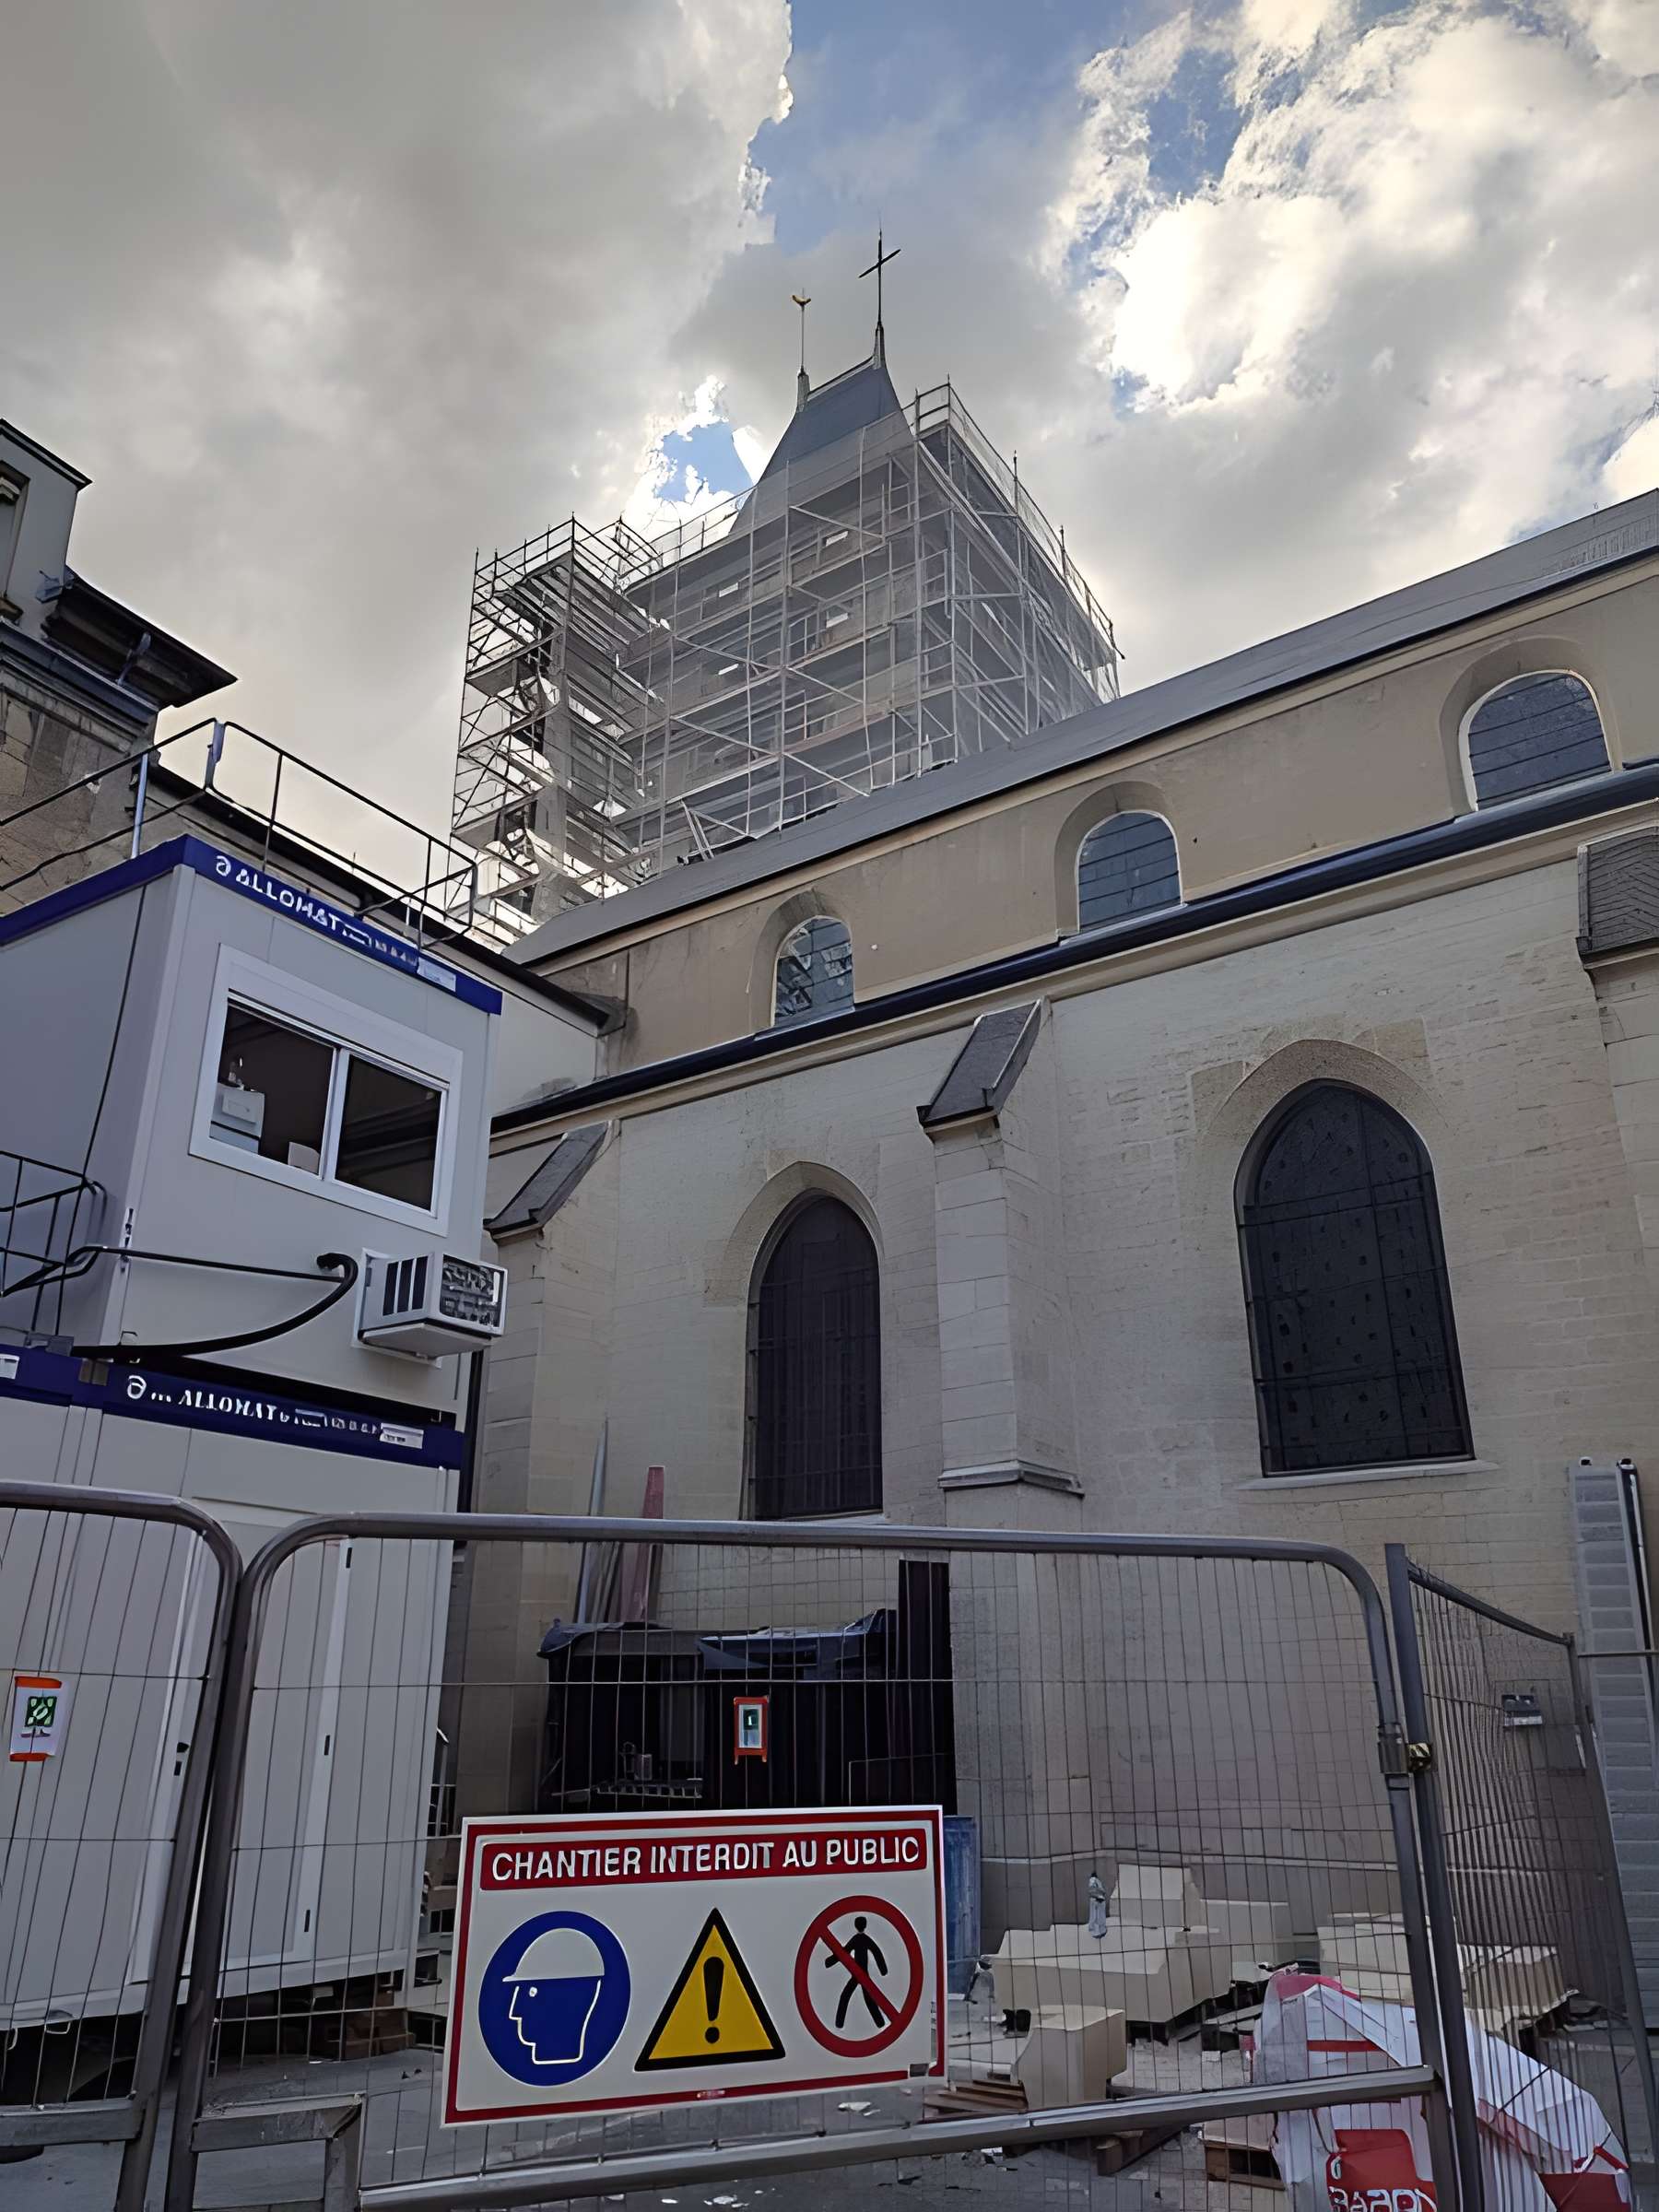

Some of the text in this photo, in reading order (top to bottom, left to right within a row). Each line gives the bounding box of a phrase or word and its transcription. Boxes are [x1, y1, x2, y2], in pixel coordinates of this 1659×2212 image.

[492, 1836, 920, 1882] CHANTIER INTERDIT AU PUBLIC
